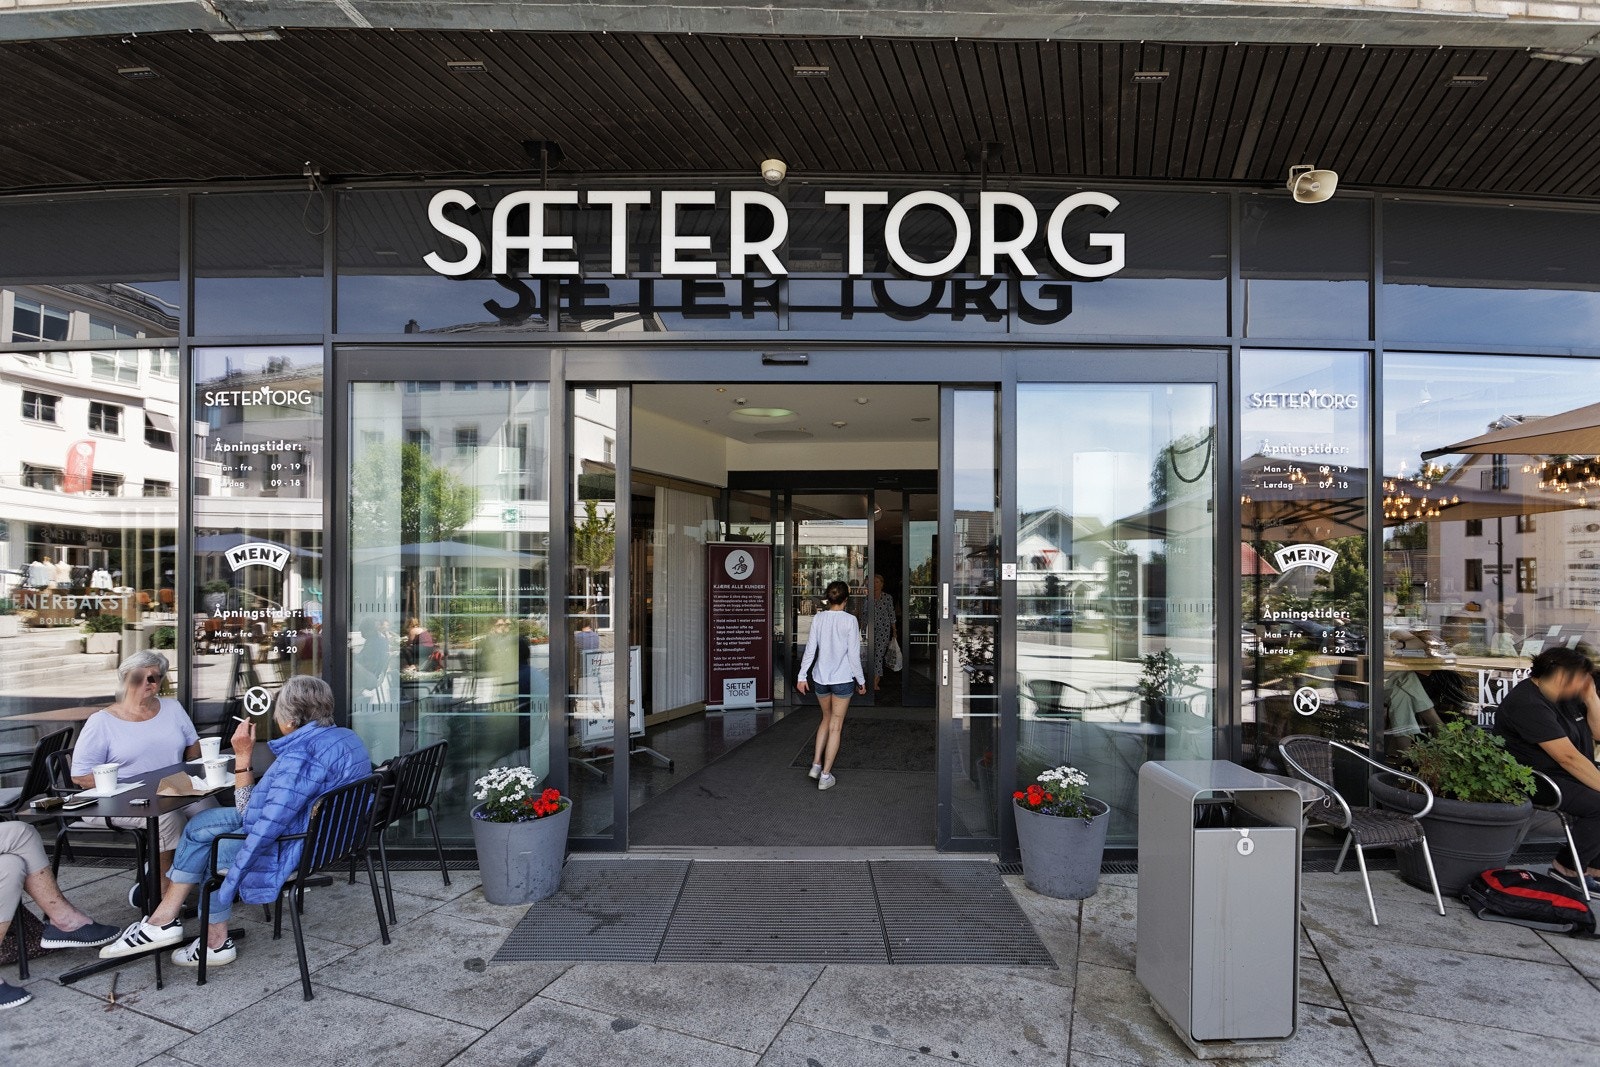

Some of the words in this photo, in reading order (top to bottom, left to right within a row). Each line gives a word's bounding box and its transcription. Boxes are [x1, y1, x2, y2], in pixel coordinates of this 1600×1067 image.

[422, 188, 790, 277] SÆTER
[824, 189, 1127, 278] TORG
[240, 463, 252, 471] fre
[270, 463, 282, 471] 09
[290, 463, 300, 471] 19
[1288, 465, 1301, 473] fre
[1264, 481, 1293, 491] Lørdag
[233, 548, 284, 564] MENY
[1283, 548, 1332, 565] MENY
[214, 604, 302, 620] Åpningstider:
[1263, 605, 1350, 621] Åpningstider:
[215, 630, 233, 638] Man
[240, 630, 252, 638] fre
[1289, 630, 1302, 639] fre
[214, 646, 244, 656] Lørdag
[1264, 646, 1294, 657] Lørdag
